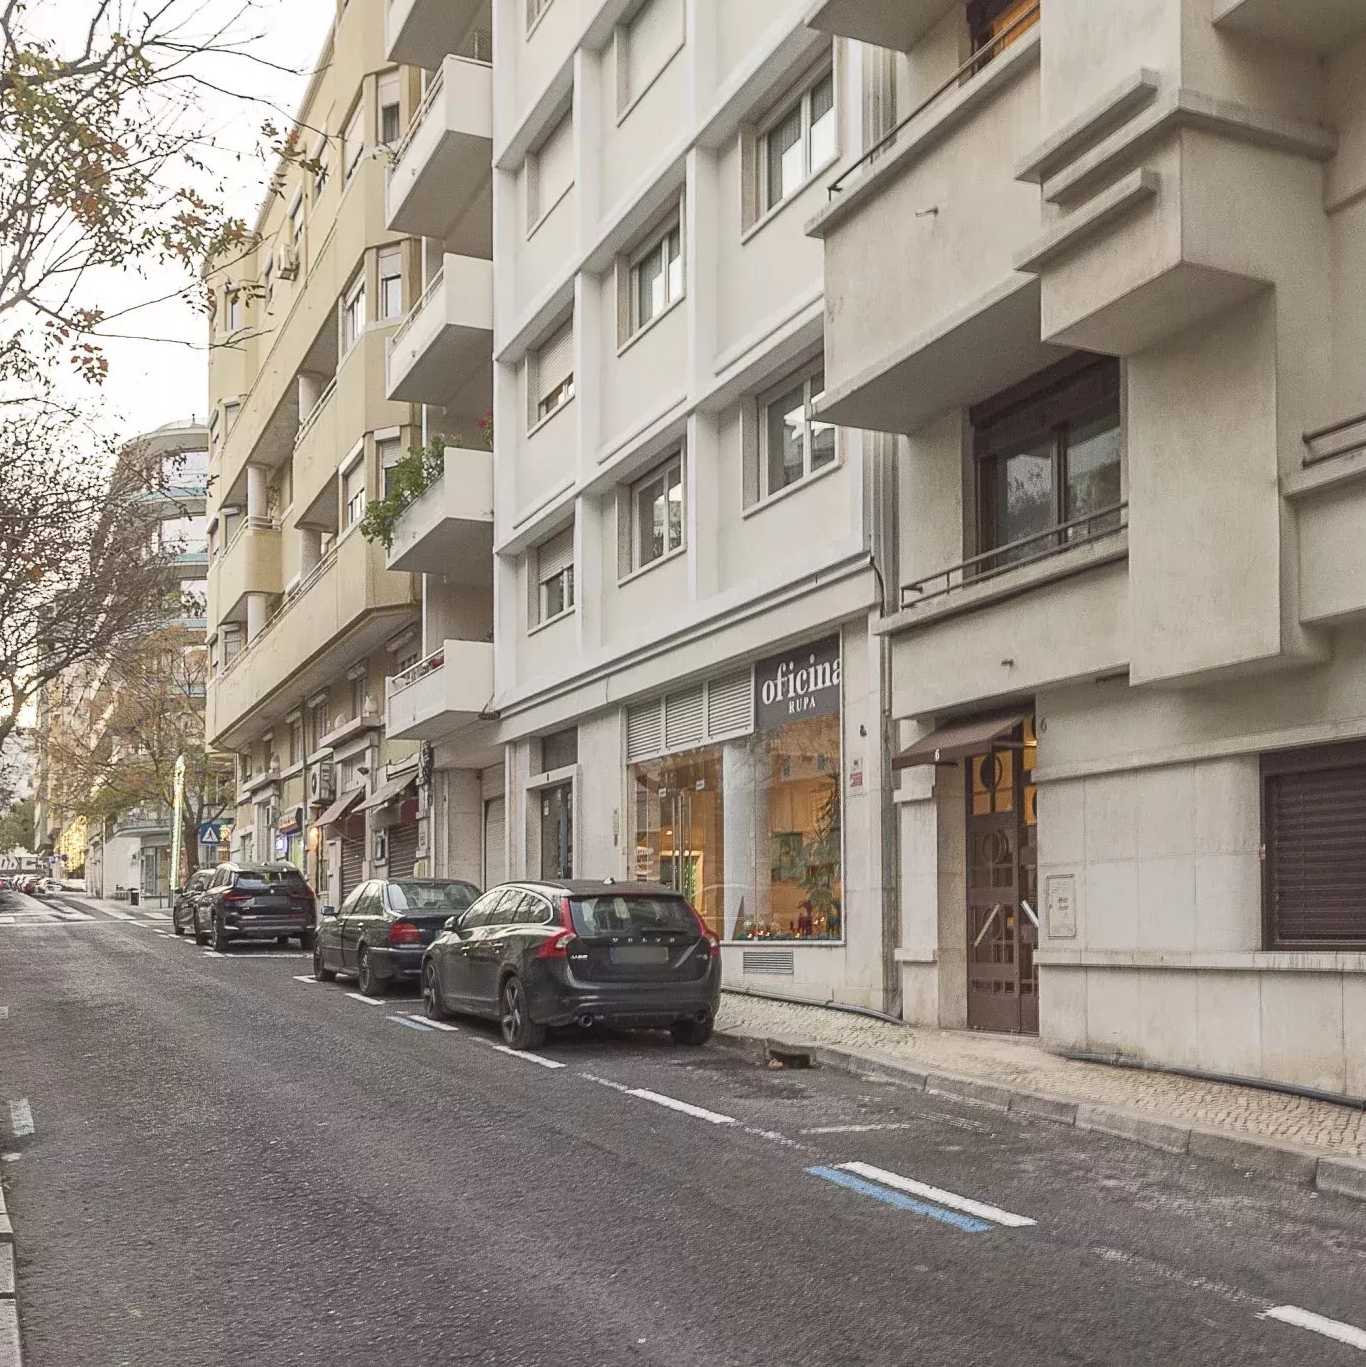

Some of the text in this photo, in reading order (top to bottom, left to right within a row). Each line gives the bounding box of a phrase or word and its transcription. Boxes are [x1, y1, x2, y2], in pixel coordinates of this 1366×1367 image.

[762, 654, 841, 705] oficina
[789, 696, 816, 714] RUPA
[934, 748, 940, 762] 6
